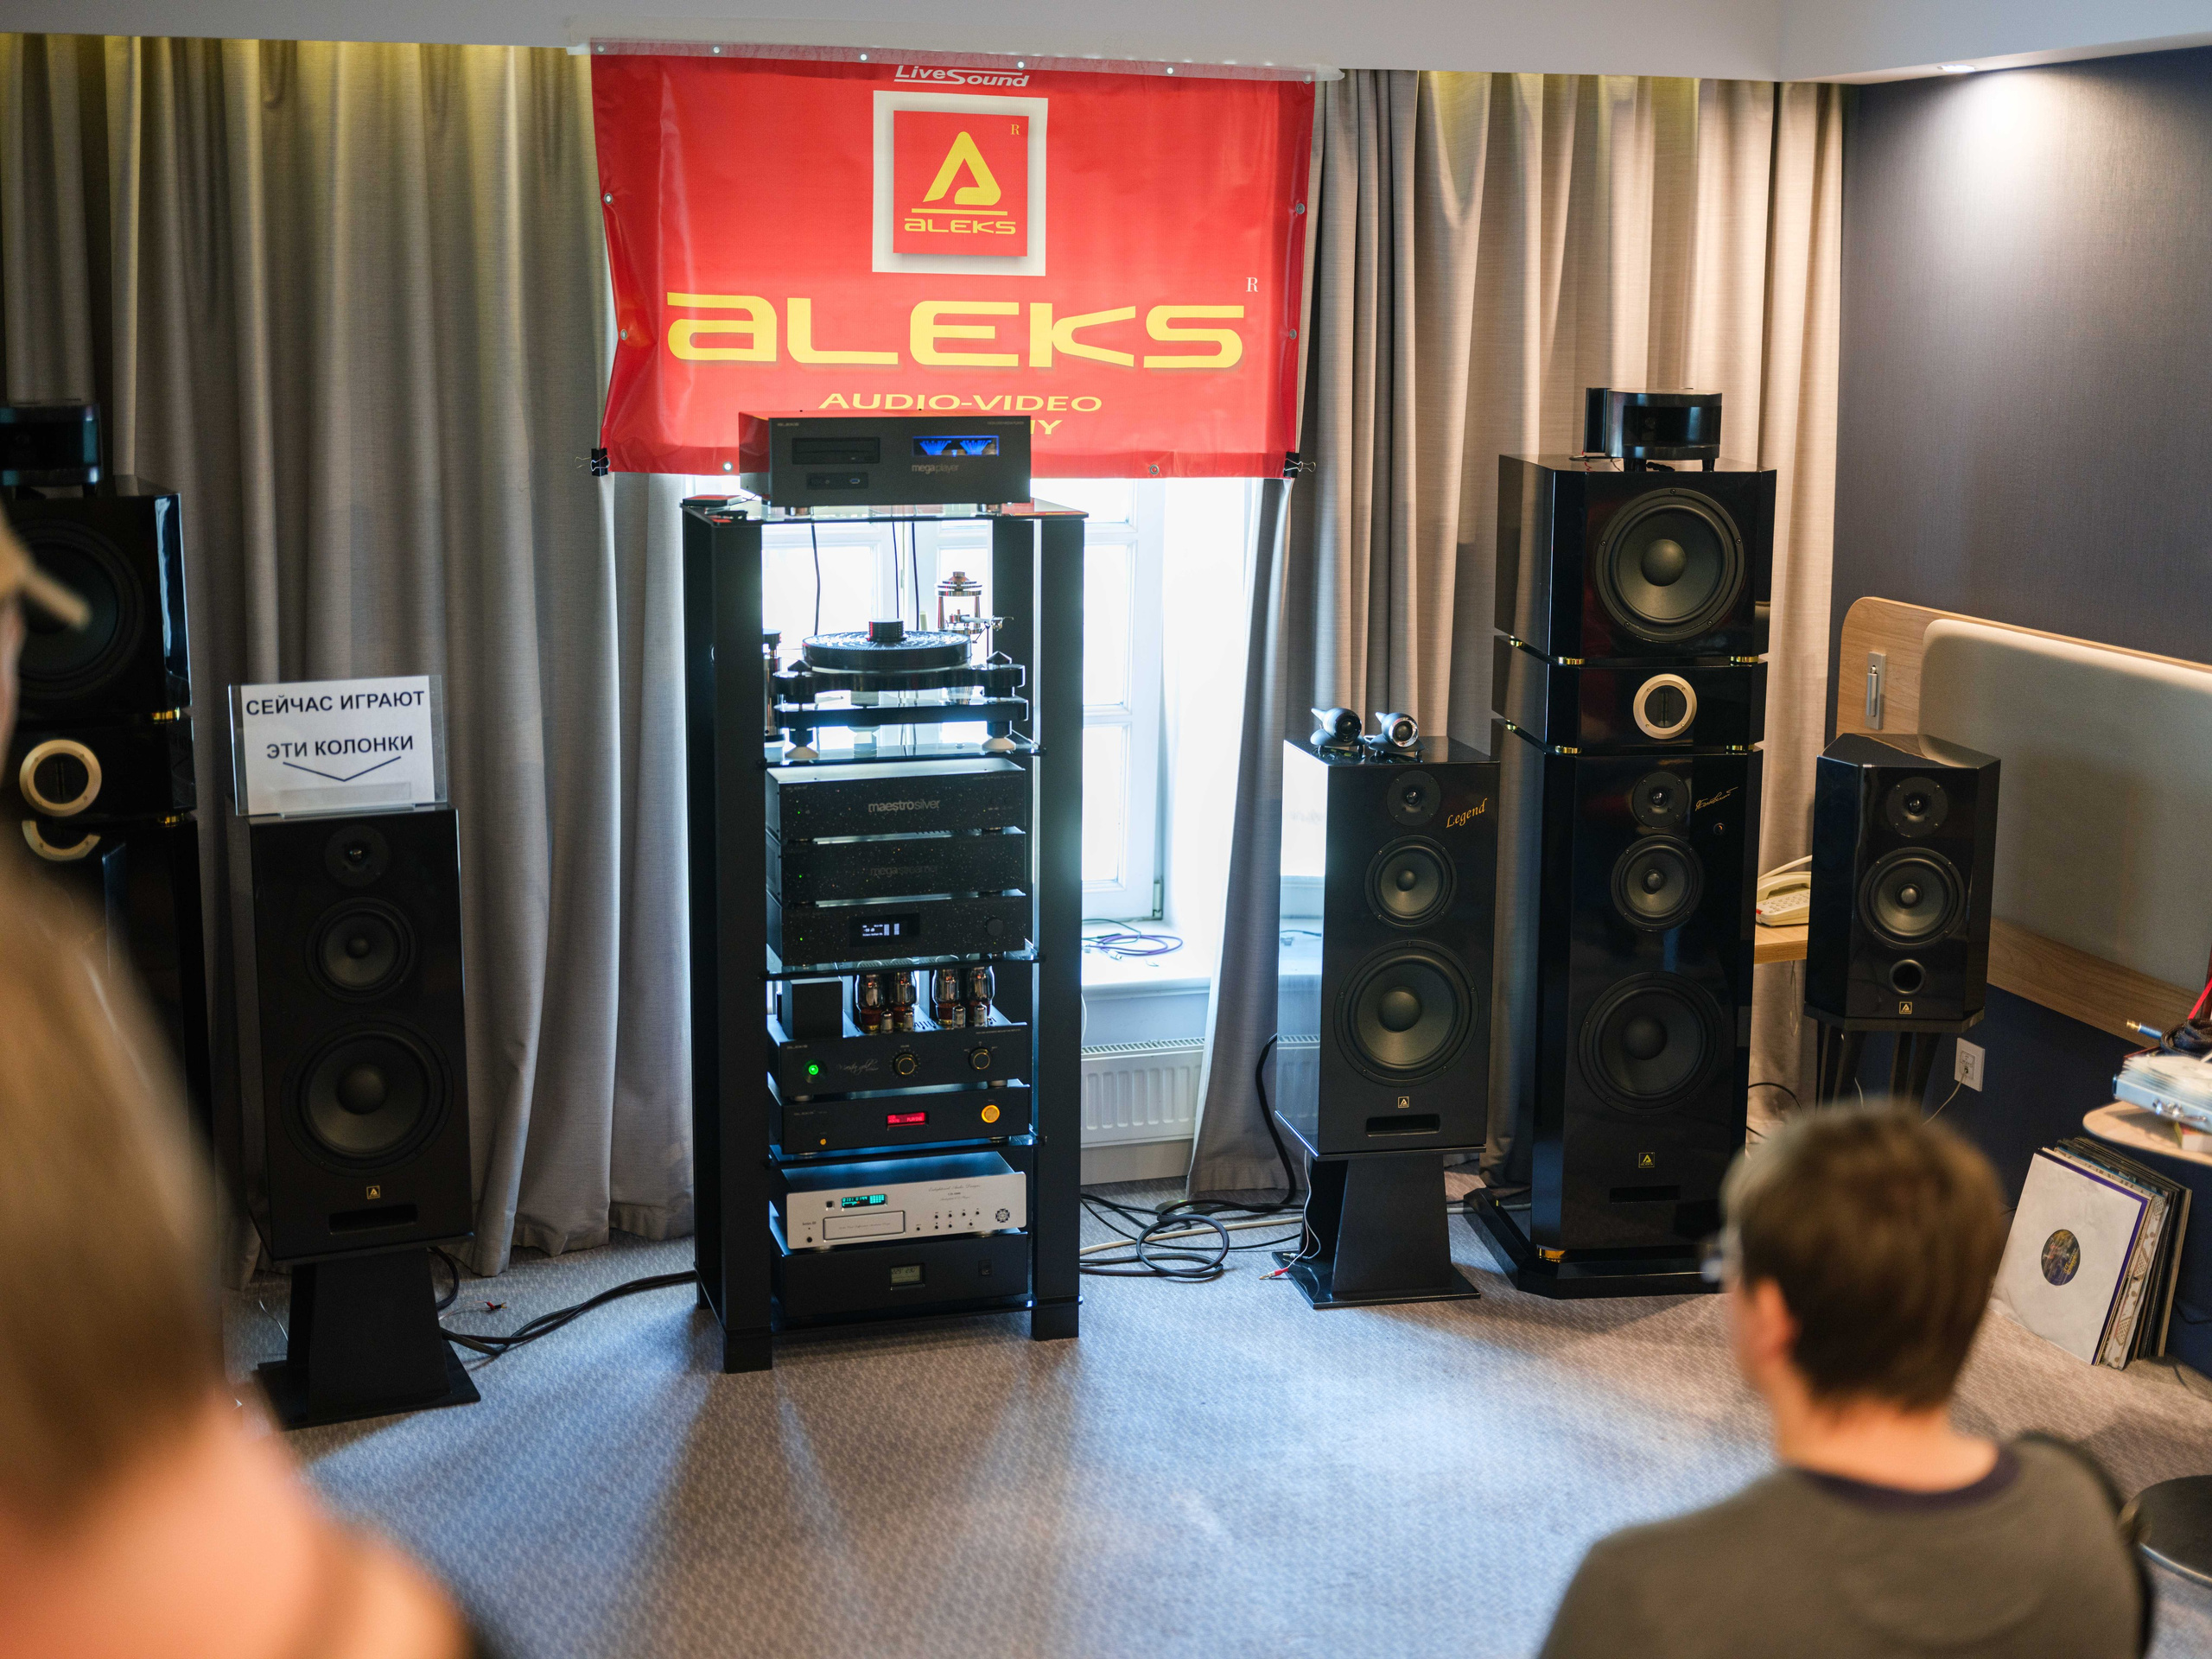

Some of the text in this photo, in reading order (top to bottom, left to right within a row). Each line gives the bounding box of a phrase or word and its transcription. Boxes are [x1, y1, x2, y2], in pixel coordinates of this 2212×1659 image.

[894, 65, 1030, 87] LiveSound
[818, 393, 1103, 412] AUDIO-VIDEO
[246, 690, 424, 715] СЕЙЧАС ИГРАЮТ
[266, 735, 413, 759] ЭТИ КОЛОНКИ
[1446, 798, 1488, 829] Legend
